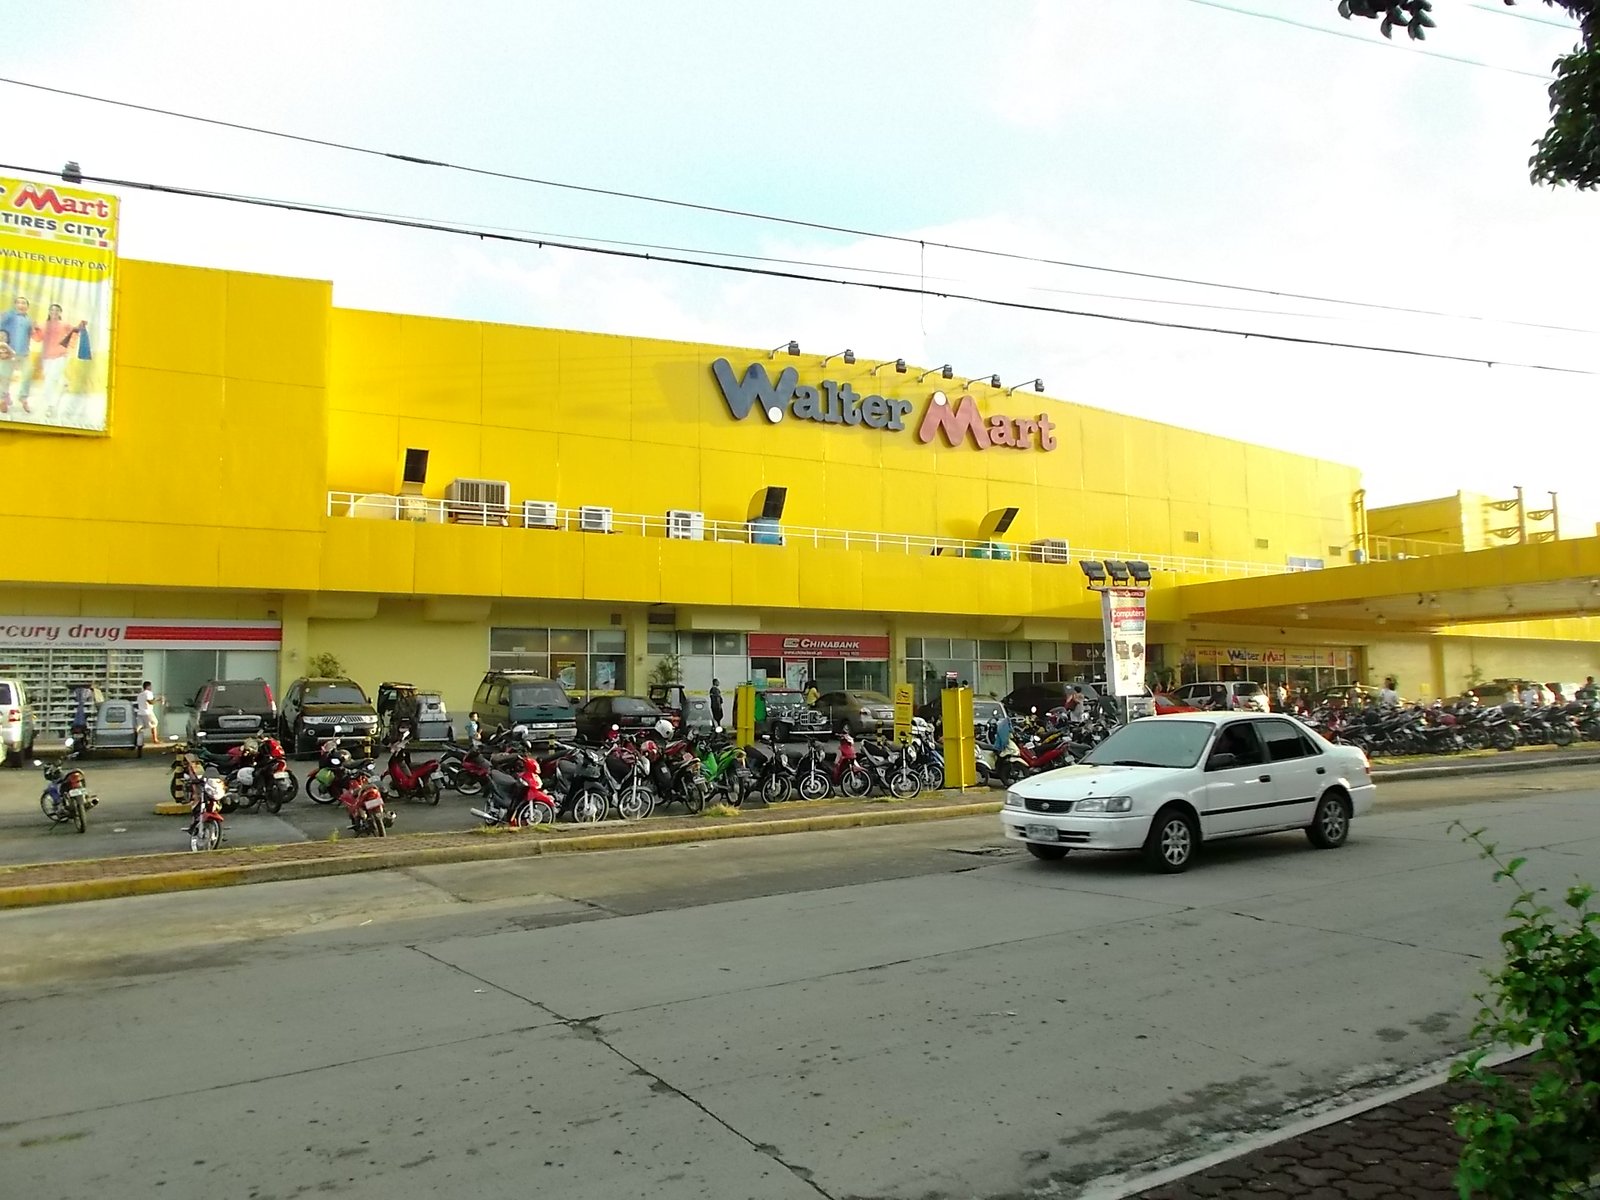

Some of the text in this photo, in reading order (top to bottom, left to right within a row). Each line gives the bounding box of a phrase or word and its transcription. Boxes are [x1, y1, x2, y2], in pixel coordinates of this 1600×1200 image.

[14, 185, 108, 217] Mart
[64, 222, 107, 238] CITY
[49, 255, 85, 268] EVERY
[712, 357, 1057, 451] Walter Mart
[1112, 609, 1144, 619] Computers
[68, 624, 120, 642] drug
[1226, 649, 1260, 661] Walter
